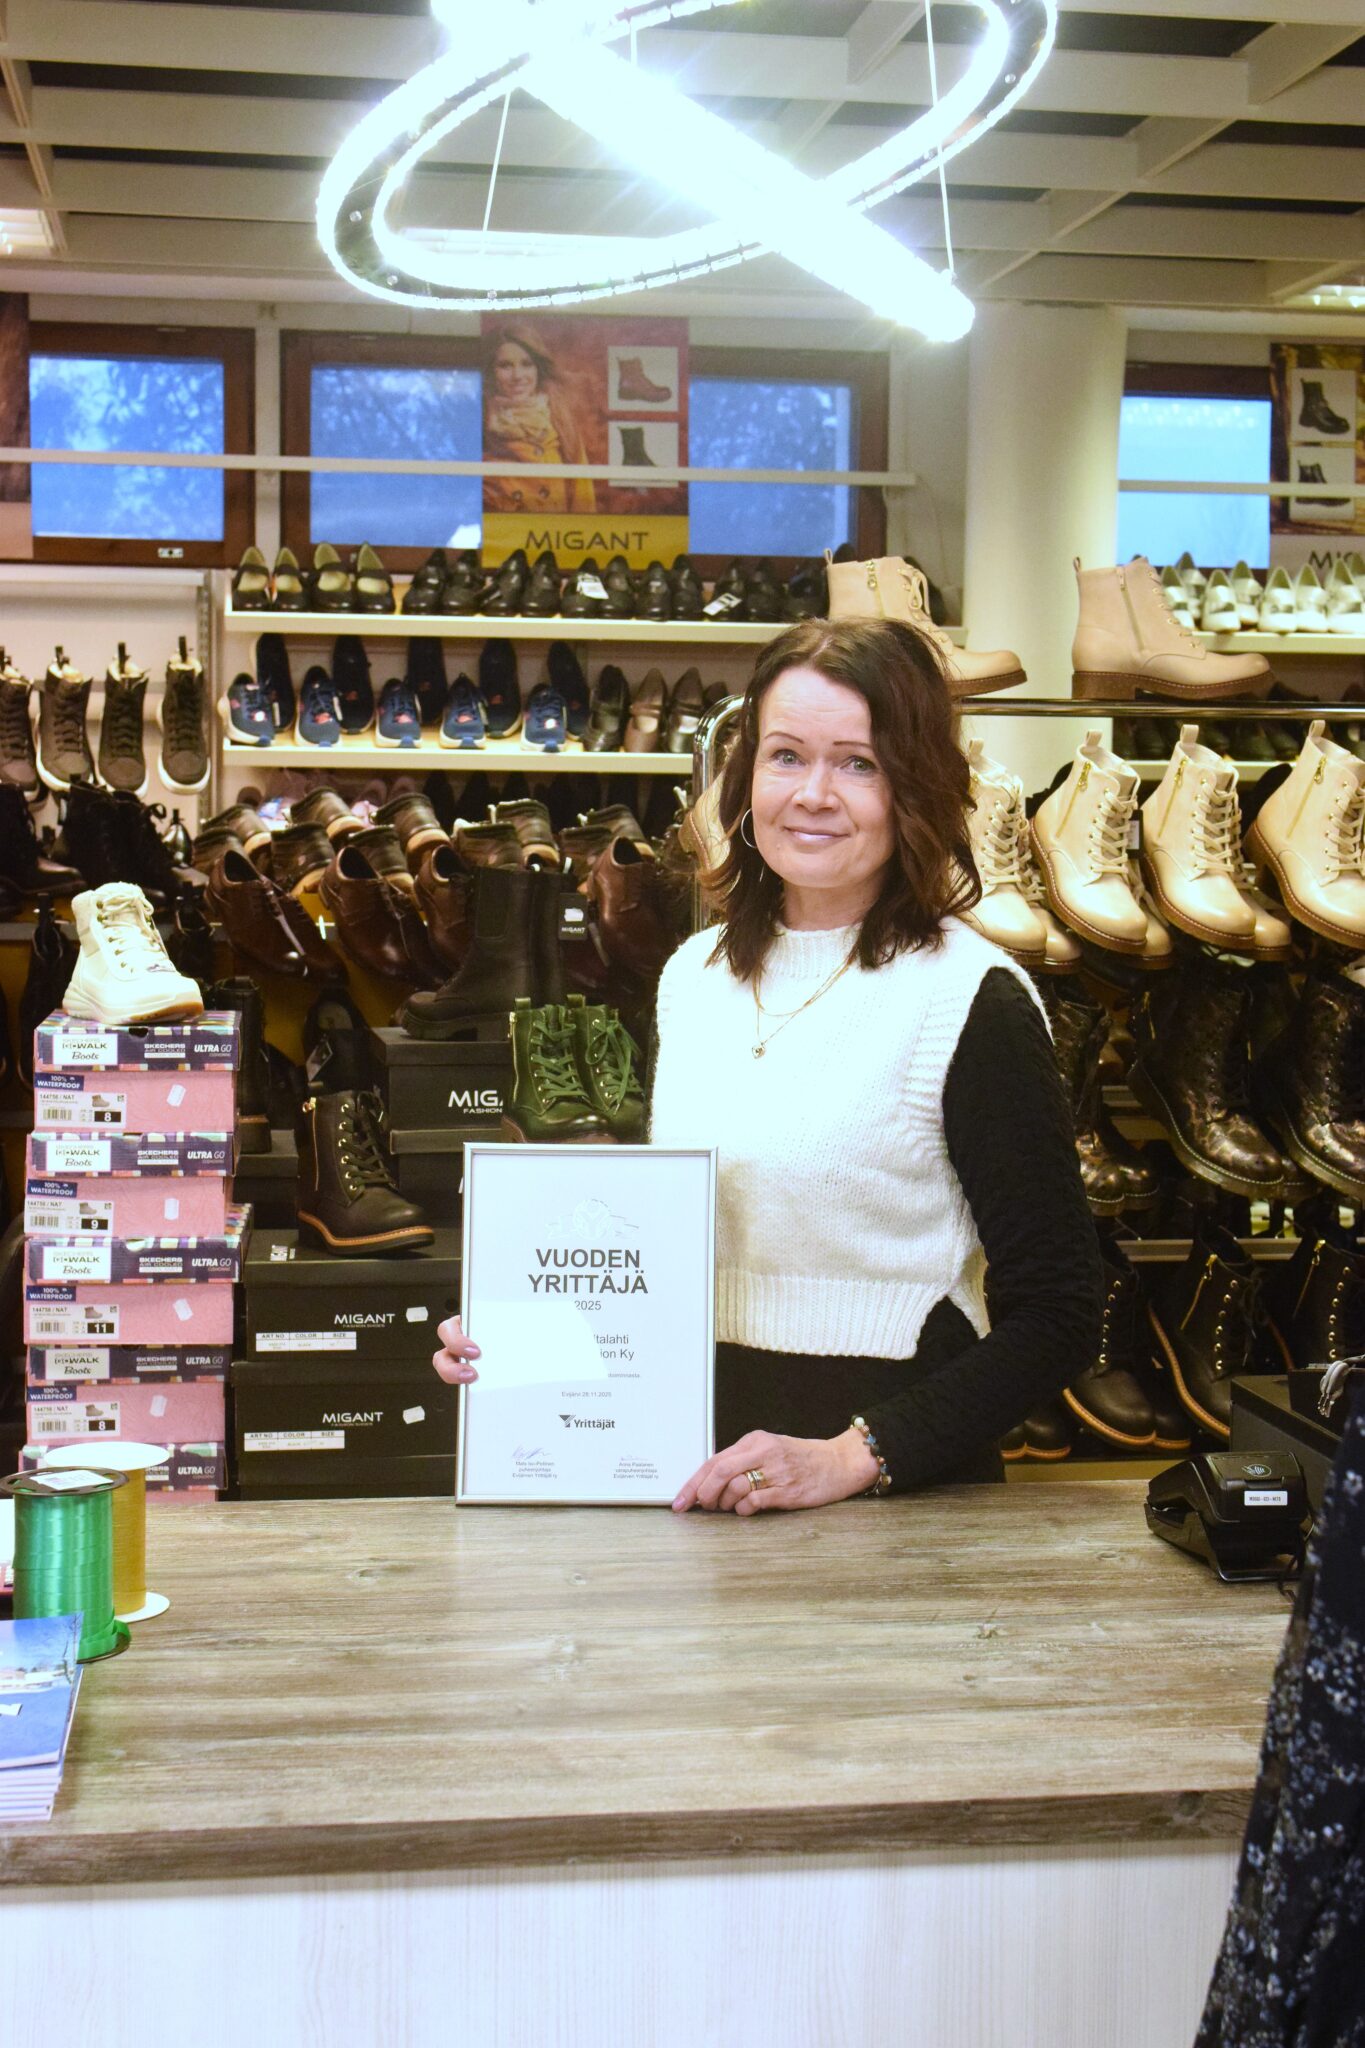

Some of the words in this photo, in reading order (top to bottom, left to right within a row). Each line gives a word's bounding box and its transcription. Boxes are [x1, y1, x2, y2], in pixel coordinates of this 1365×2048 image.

[525, 530, 649, 550] MIGANT
[194, 1044, 219, 1053] ULTRA
[220, 1044, 232, 1052] GO
[72, 1051, 99, 1060] Boots
[37, 1080, 80, 1089] WATERPROOF
[448, 1090, 503, 1107] MIG
[104, 1112, 112, 1122] 8
[187, 1151, 212, 1159] ULTRA
[213, 1151, 225, 1159] GO
[65, 1158, 92, 1167] Boots
[30, 1187, 73, 1196] WATERPROOF
[91, 1220, 99, 1229] 9
[191, 1258, 218, 1267] ULTRA
[219, 1258, 232, 1266] GO
[535, 1249, 640, 1268] VUODEN
[63, 1265, 91, 1274] Boots
[528, 1270, 648, 1294] YRITTÄJÄ
[574, 1300, 602, 1311] 2025
[334, 1313, 396, 1325] MIGANT
[94, 1323, 106, 1333] 11
[594, 1334, 629, 1344] talahti
[620, 1348, 635, 1361] Ky
[185, 1357, 211, 1365] ULTRA
[211, 1356, 223, 1364] GO
[64, 1366, 91, 1375] Boots
[322, 1411, 384, 1423] MIGANT
[99, 1420, 106, 1430] 8
[574, 1418, 615, 1430] Yrittäjät
[177, 1466, 203, 1475] ULTRA
[203, 1466, 216, 1474] GO
